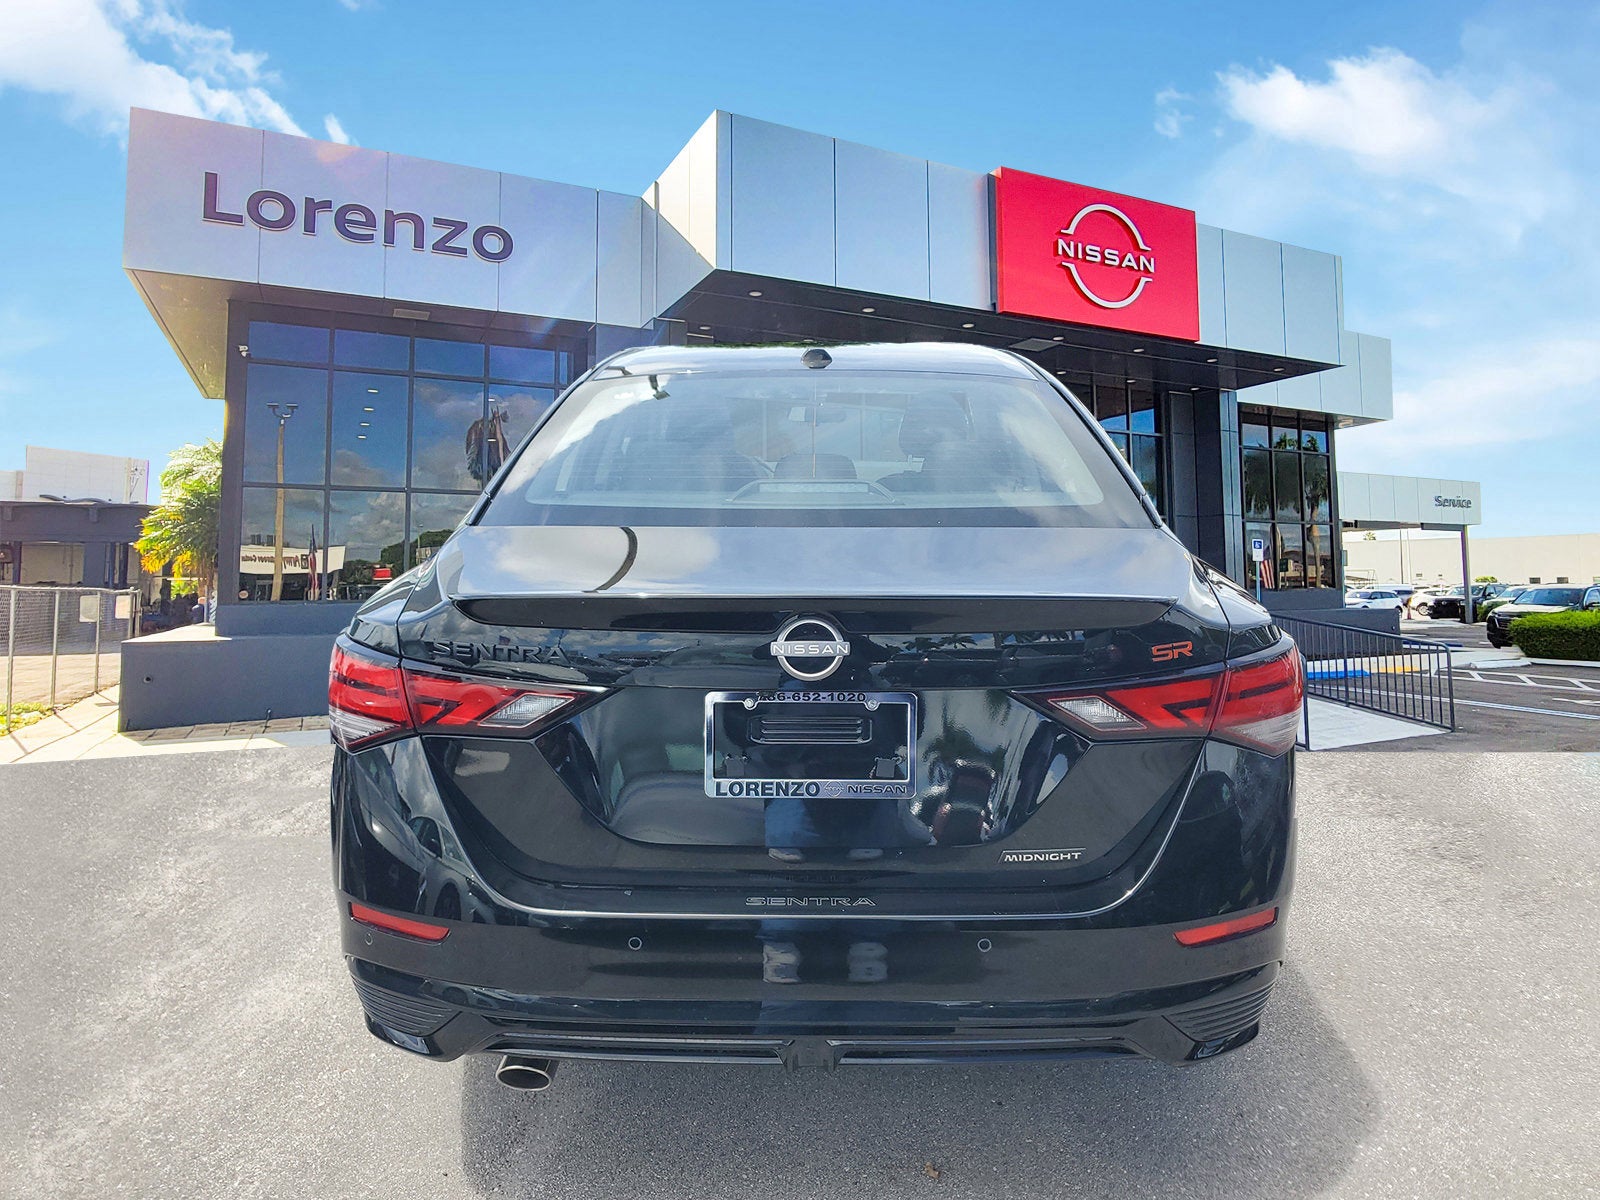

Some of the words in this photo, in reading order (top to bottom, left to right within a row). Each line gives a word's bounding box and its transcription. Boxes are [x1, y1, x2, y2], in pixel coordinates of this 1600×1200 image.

[202, 171, 515, 263] Lorenzo
[1057, 237, 1155, 273] NISSAN
[1434, 495, 1472, 509] Service
[431, 640, 571, 664] SENTRA
[773, 644, 848, 655] NISSAN
[1151, 640, 1193, 662] SR
[715, 781, 821, 797] LORENZO
[847, 784, 907, 795] NISSAN
[1004, 852, 1082, 862] MIDNIGHT
[745, 897, 876, 906] SENTRA
